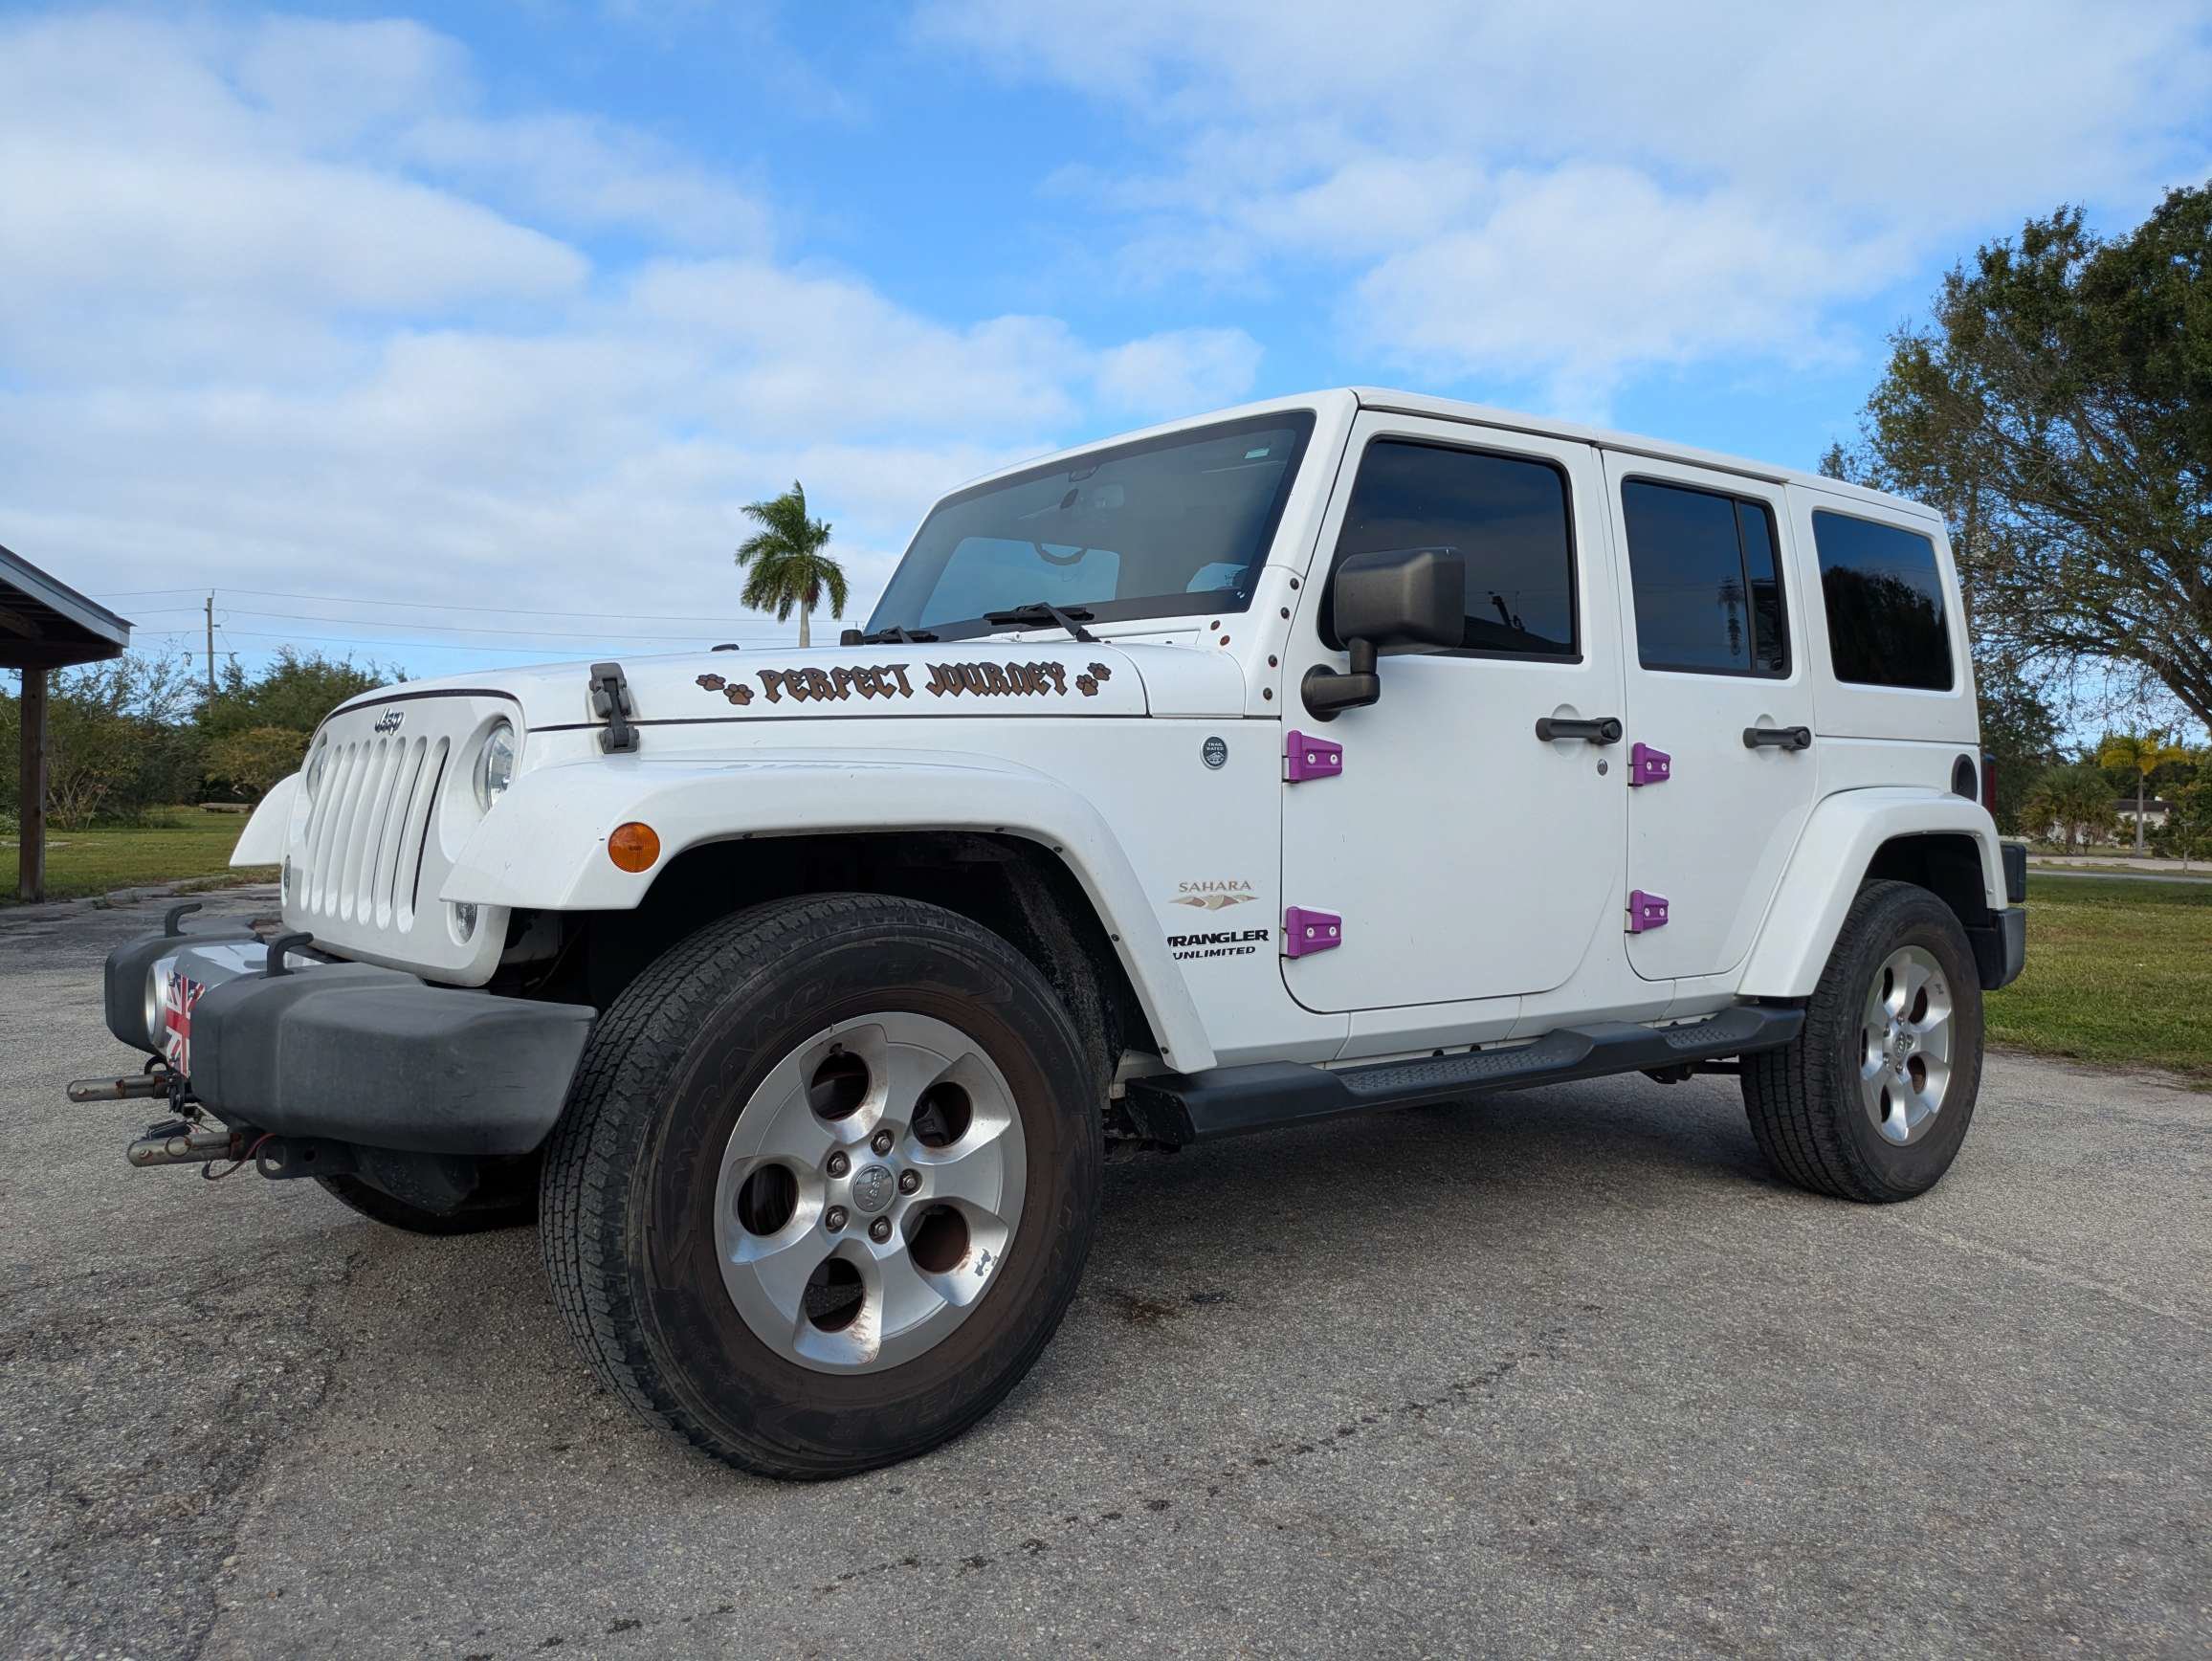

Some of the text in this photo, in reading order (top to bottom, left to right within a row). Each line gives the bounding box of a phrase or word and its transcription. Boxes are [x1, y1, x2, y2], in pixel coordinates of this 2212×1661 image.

[755, 661, 1069, 704] PERFECT JOURNEY
[374, 707, 405, 737] Jeep
[1179, 880, 1251, 893] SAHARA
[1173, 945, 1256, 960] UNLIMITED
